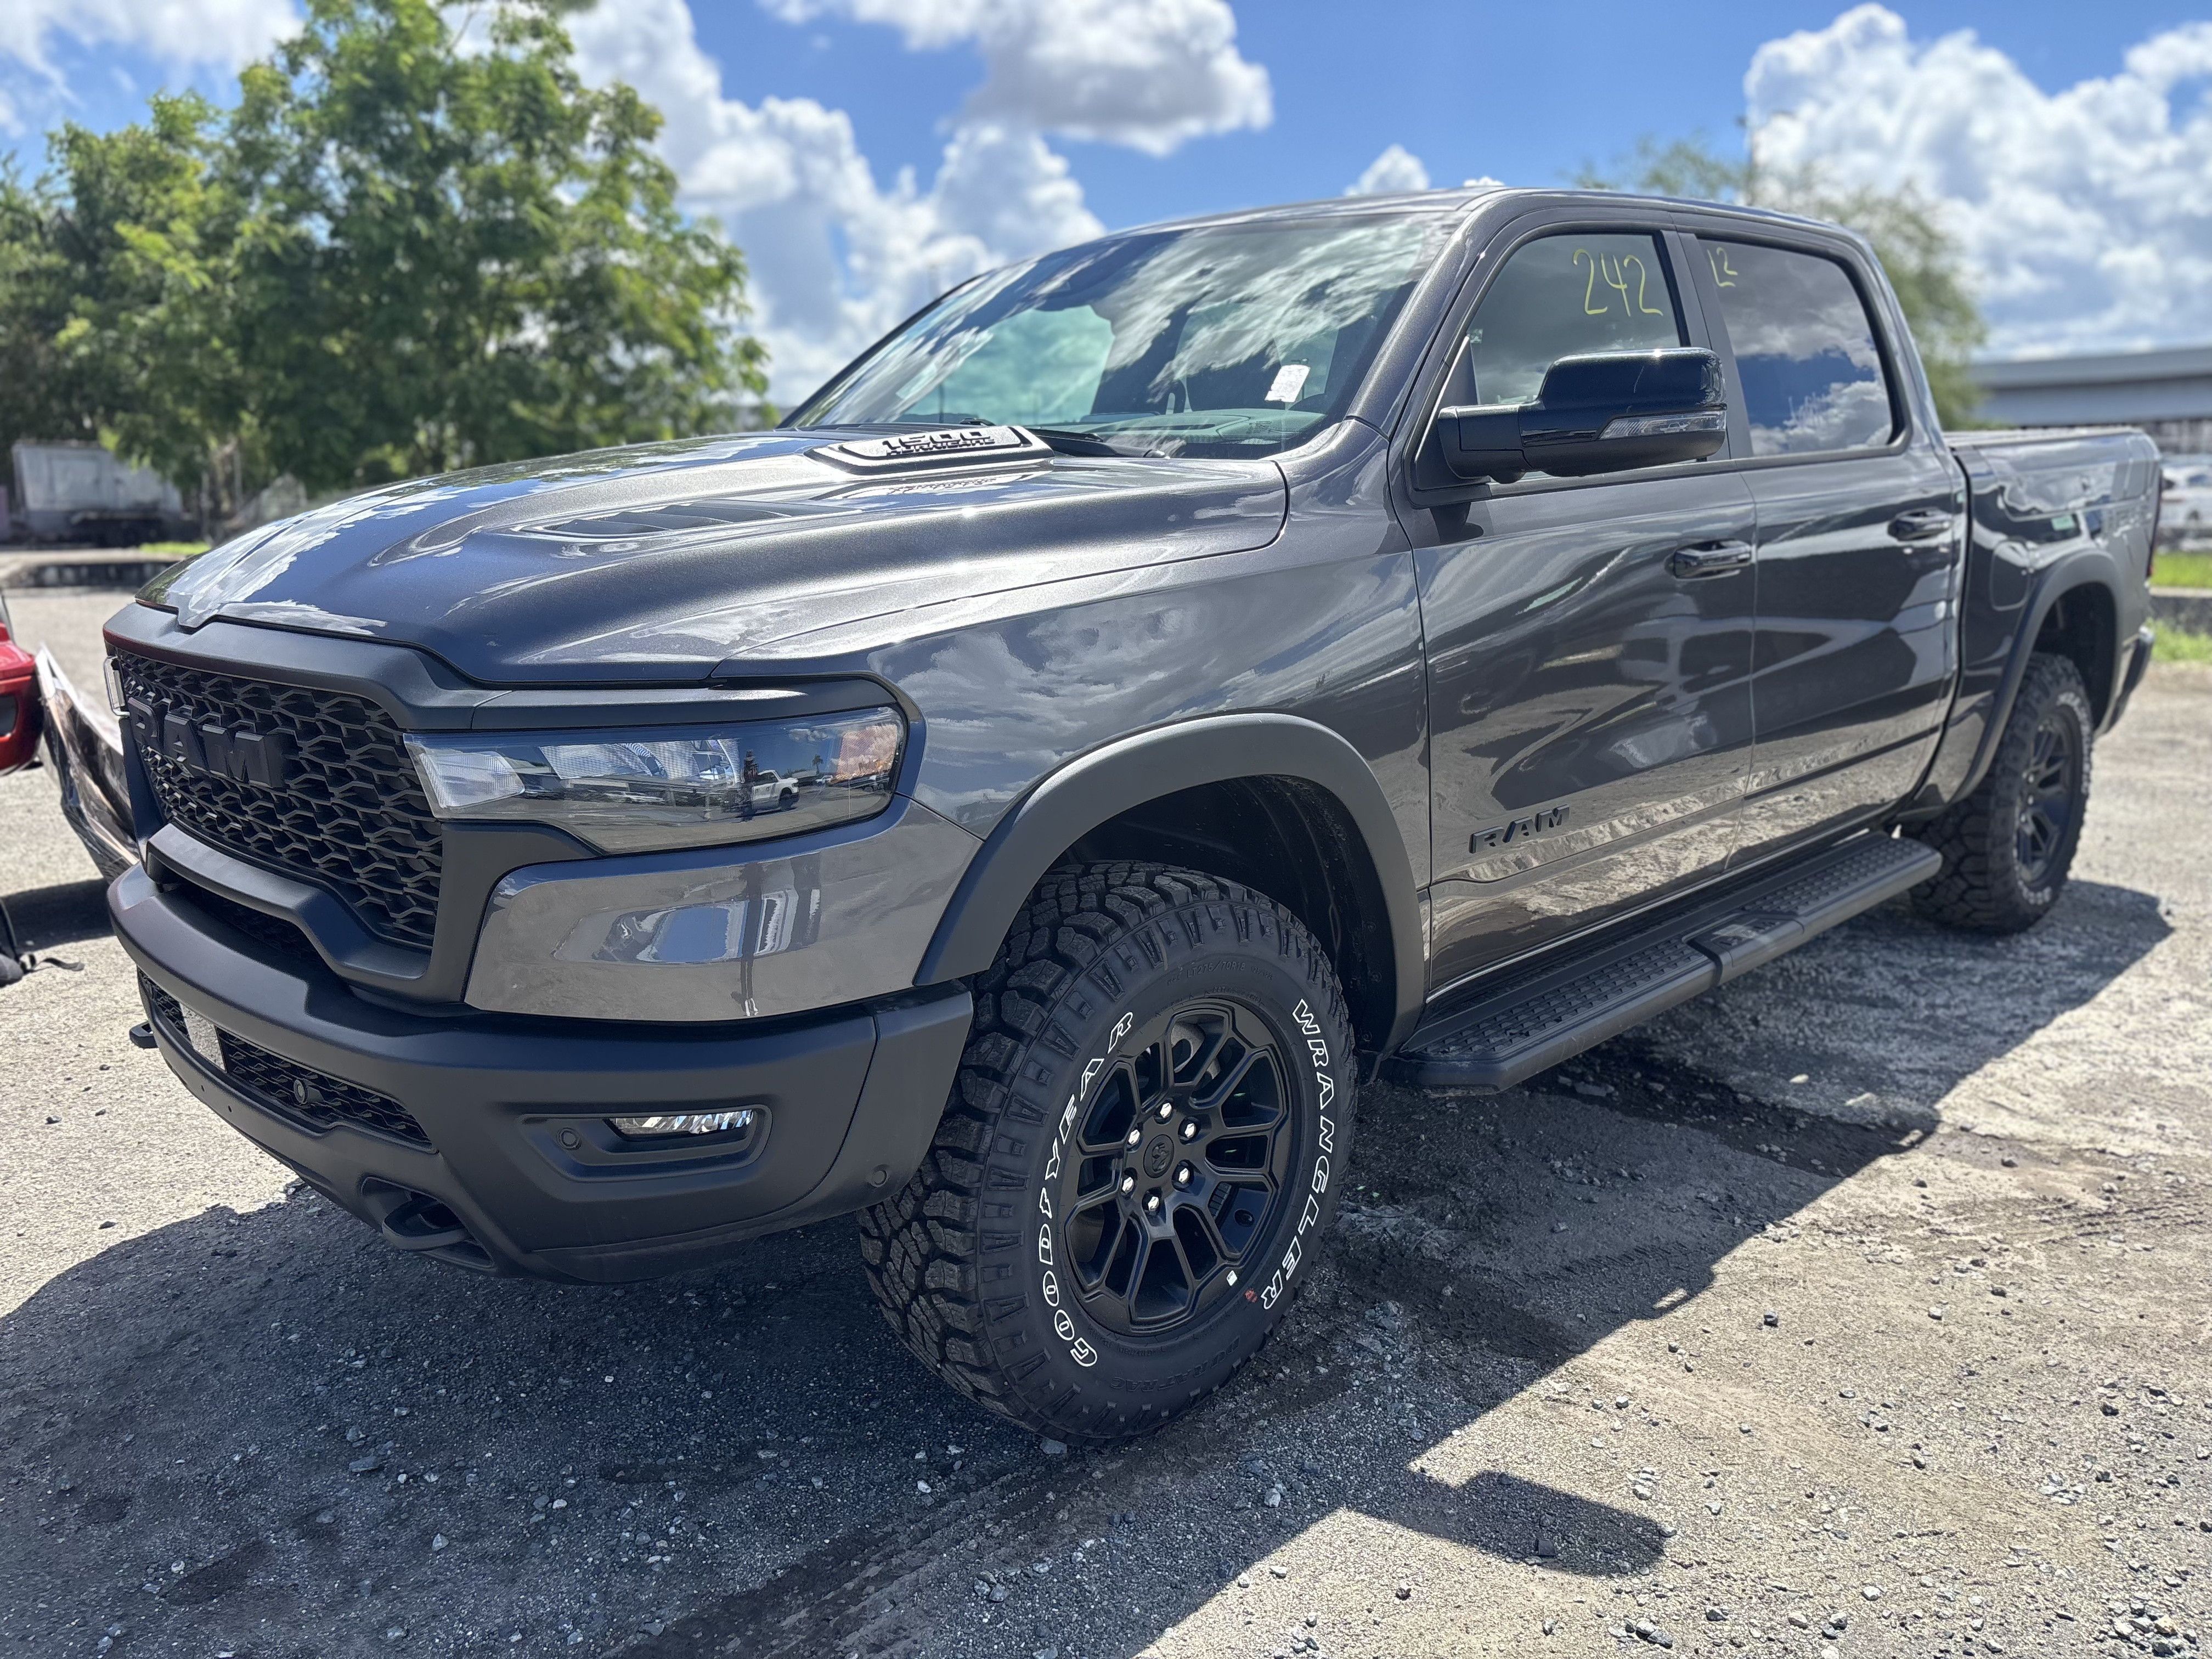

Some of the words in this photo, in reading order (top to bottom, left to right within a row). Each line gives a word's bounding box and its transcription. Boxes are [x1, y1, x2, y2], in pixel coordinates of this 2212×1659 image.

[1573, 249, 1663, 317] 242
[882, 430, 991, 450] 1500
[128, 696, 277, 787] RAM
[1468, 804, 1570, 854] RAM
[1187, 960, 1246, 978] LT275/70R18
[1260, 998, 1335, 1310] WRANGLER
[1039, 1012, 1133, 1367] GOODYEAR
